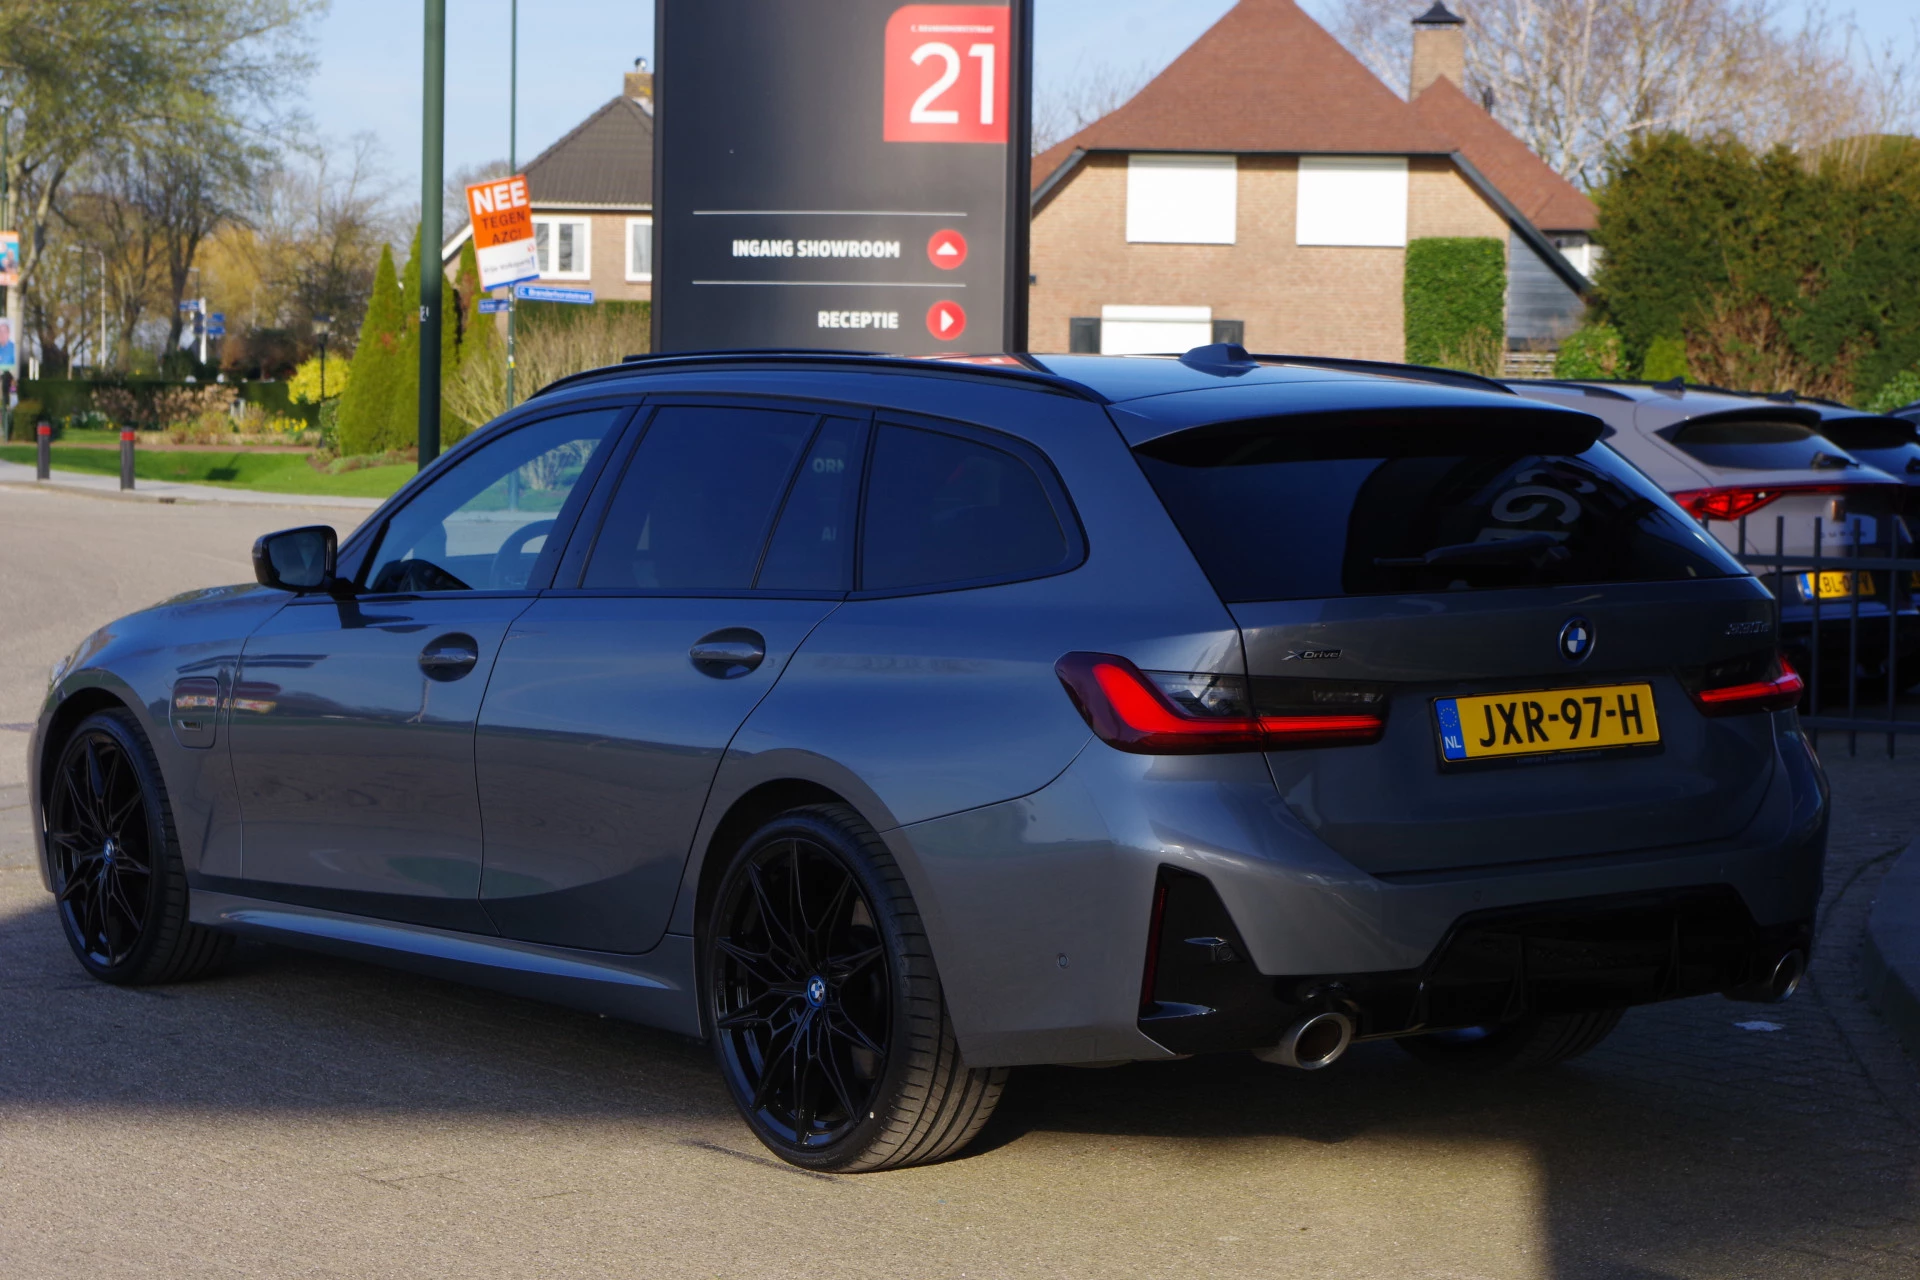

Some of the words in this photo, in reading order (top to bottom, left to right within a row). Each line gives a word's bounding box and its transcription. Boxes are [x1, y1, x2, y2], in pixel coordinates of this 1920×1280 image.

[909, 41, 995, 125] 21
[472, 181, 527, 215] NEE
[482, 211, 525, 230] TEGEN
[732, 240, 794, 257] INGANG
[797, 241, 900, 258] SHOWROOM
[817, 310, 899, 329] RECEPTIE
[1479, 693, 1644, 748] JXR-97-H
[1445, 735, 1462, 749] NL
